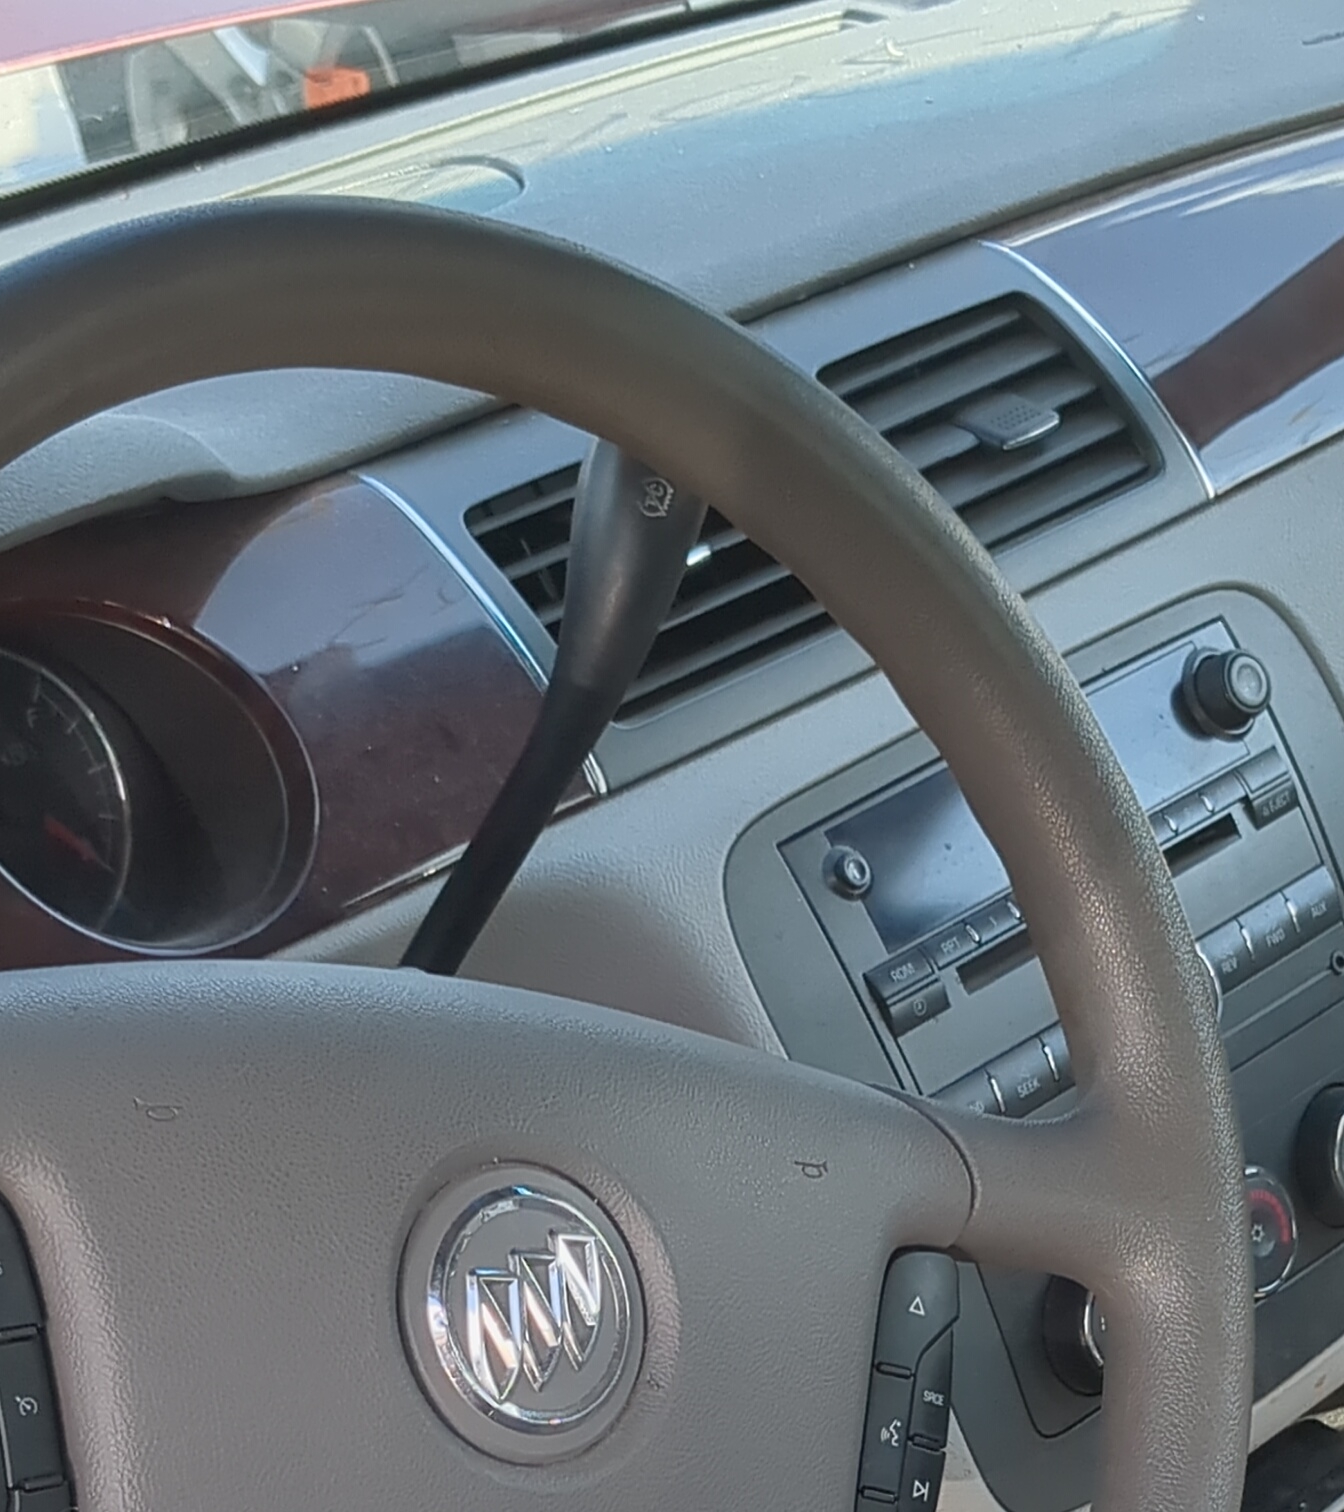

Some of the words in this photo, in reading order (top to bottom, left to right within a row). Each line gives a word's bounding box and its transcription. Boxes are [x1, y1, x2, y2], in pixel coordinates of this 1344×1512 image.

[1220, 956, 1238, 974] REV
[1265, 929, 1286, 948] FWD
[1311, 904, 1328, 919] AUX
[1016, 1077, 1041, 1098] SEEK
